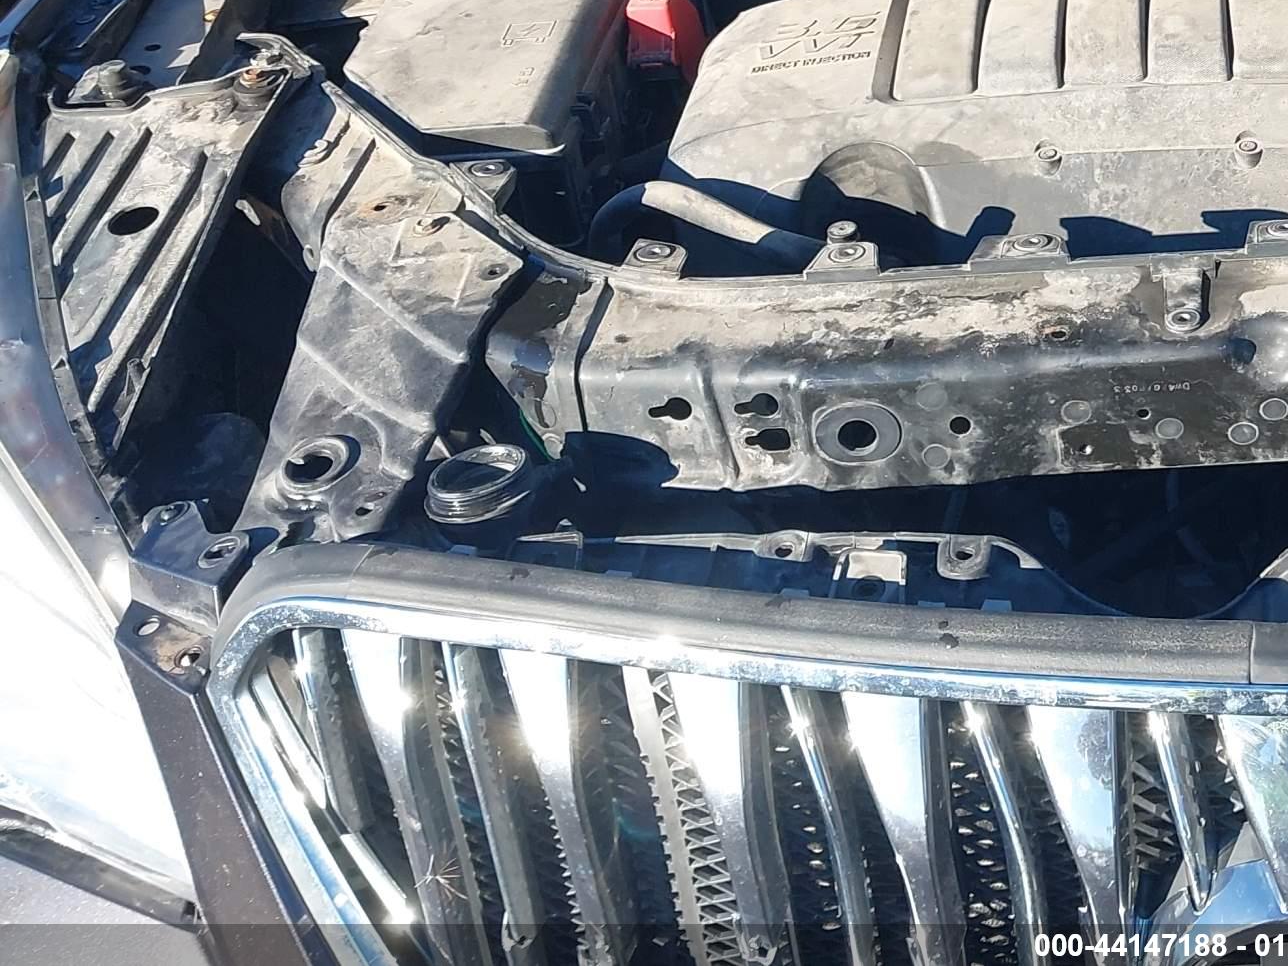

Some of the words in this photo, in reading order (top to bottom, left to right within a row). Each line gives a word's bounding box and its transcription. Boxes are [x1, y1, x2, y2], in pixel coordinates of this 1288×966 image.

[769, 11, 881, 41] 3.6
[759, 30, 875, 60] VVT
[751, 59, 800, 74] DIRECT
[802, 50, 872, 67] INJECTION
